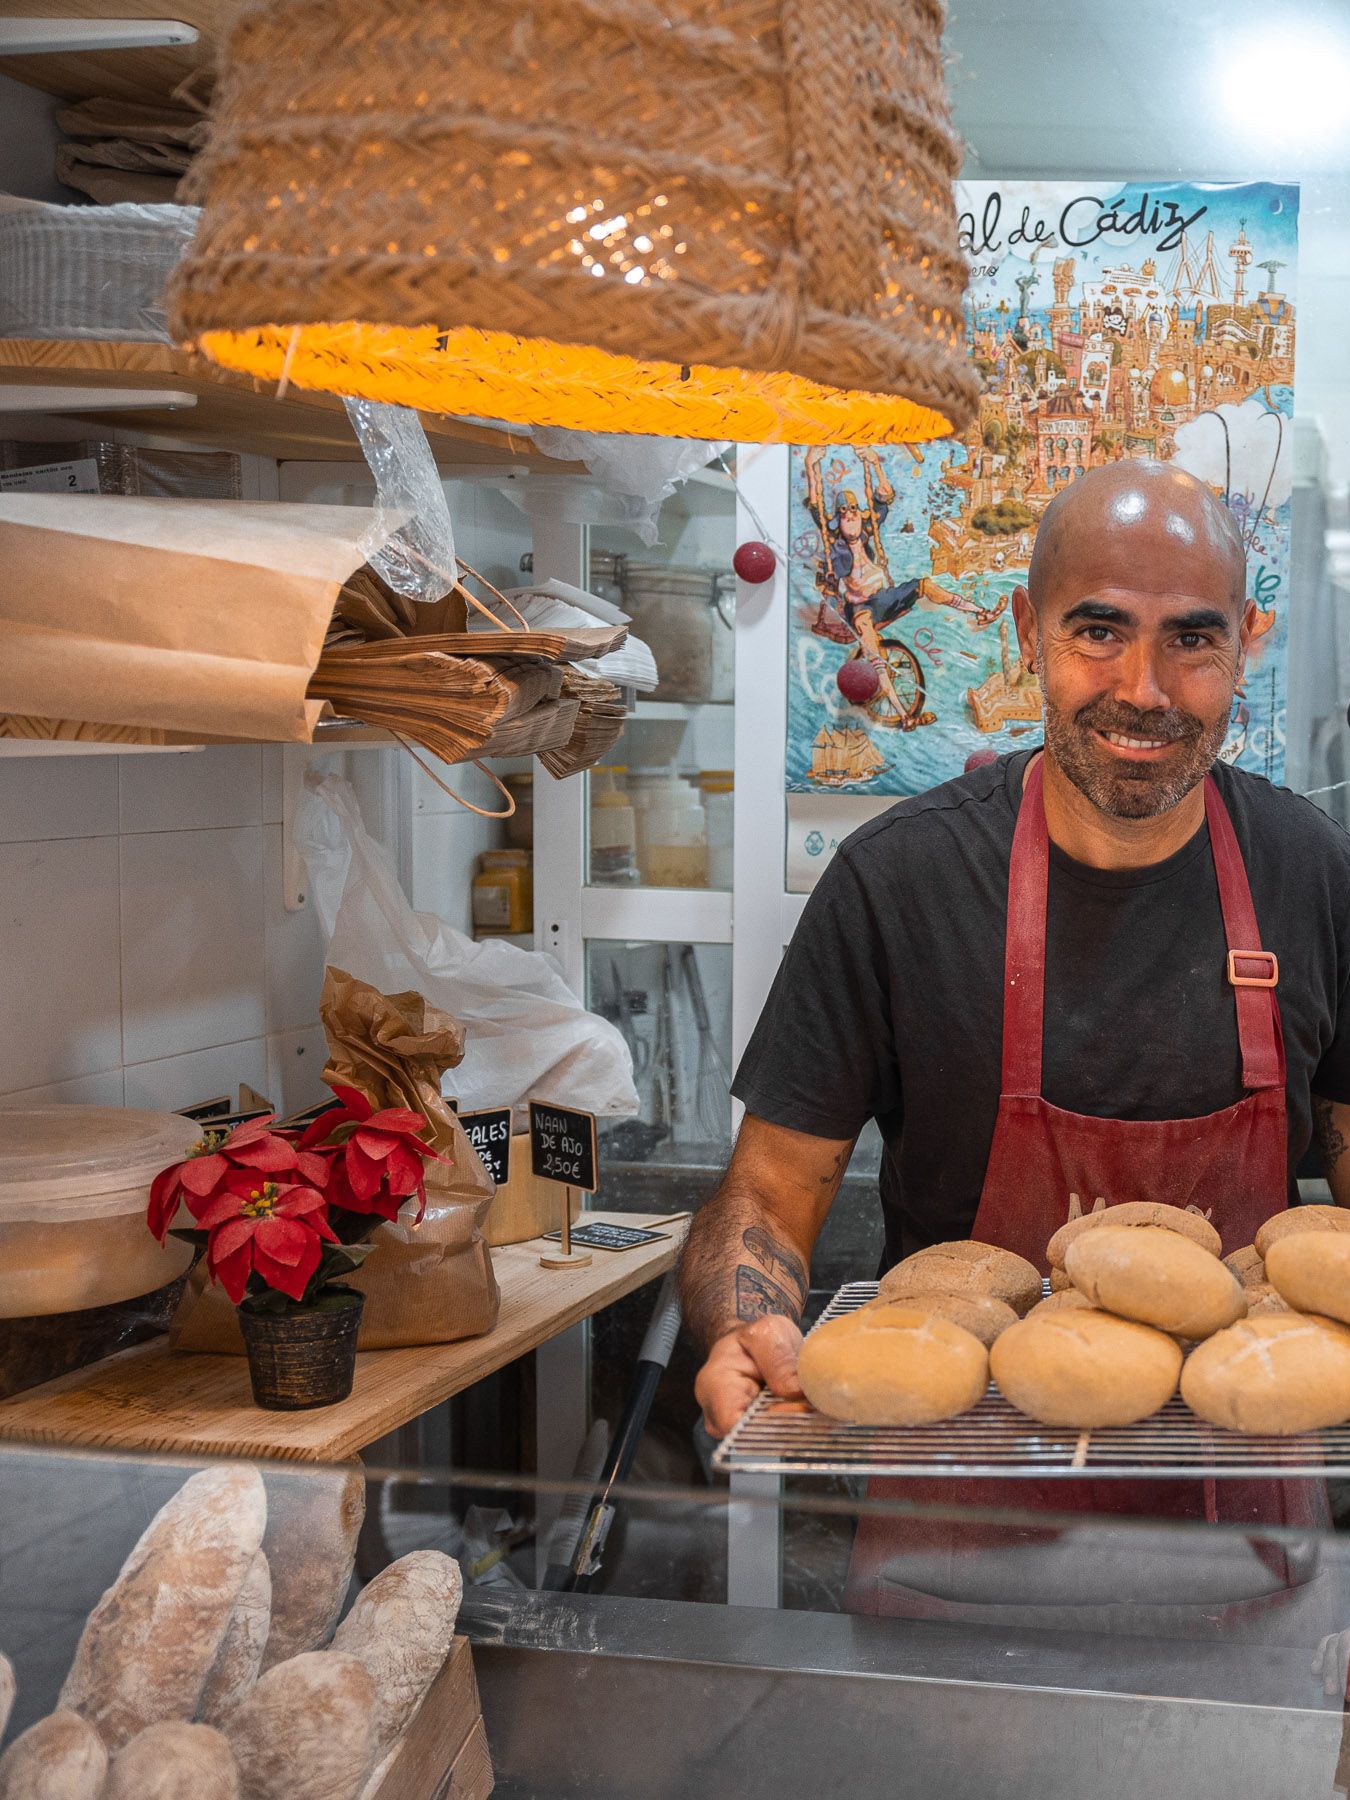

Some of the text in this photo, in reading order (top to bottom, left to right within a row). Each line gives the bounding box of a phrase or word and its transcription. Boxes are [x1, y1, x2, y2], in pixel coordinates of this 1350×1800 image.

[1008, 205, 1054, 245] de
[1059, 192, 1208, 252] Cádiz
[67, 474, 77, 487] 2
[535, 1112, 568, 1134] NAAN
[541, 1132, 583, 1157] DE AJO
[542, 1153, 581, 1179] 2,50€
